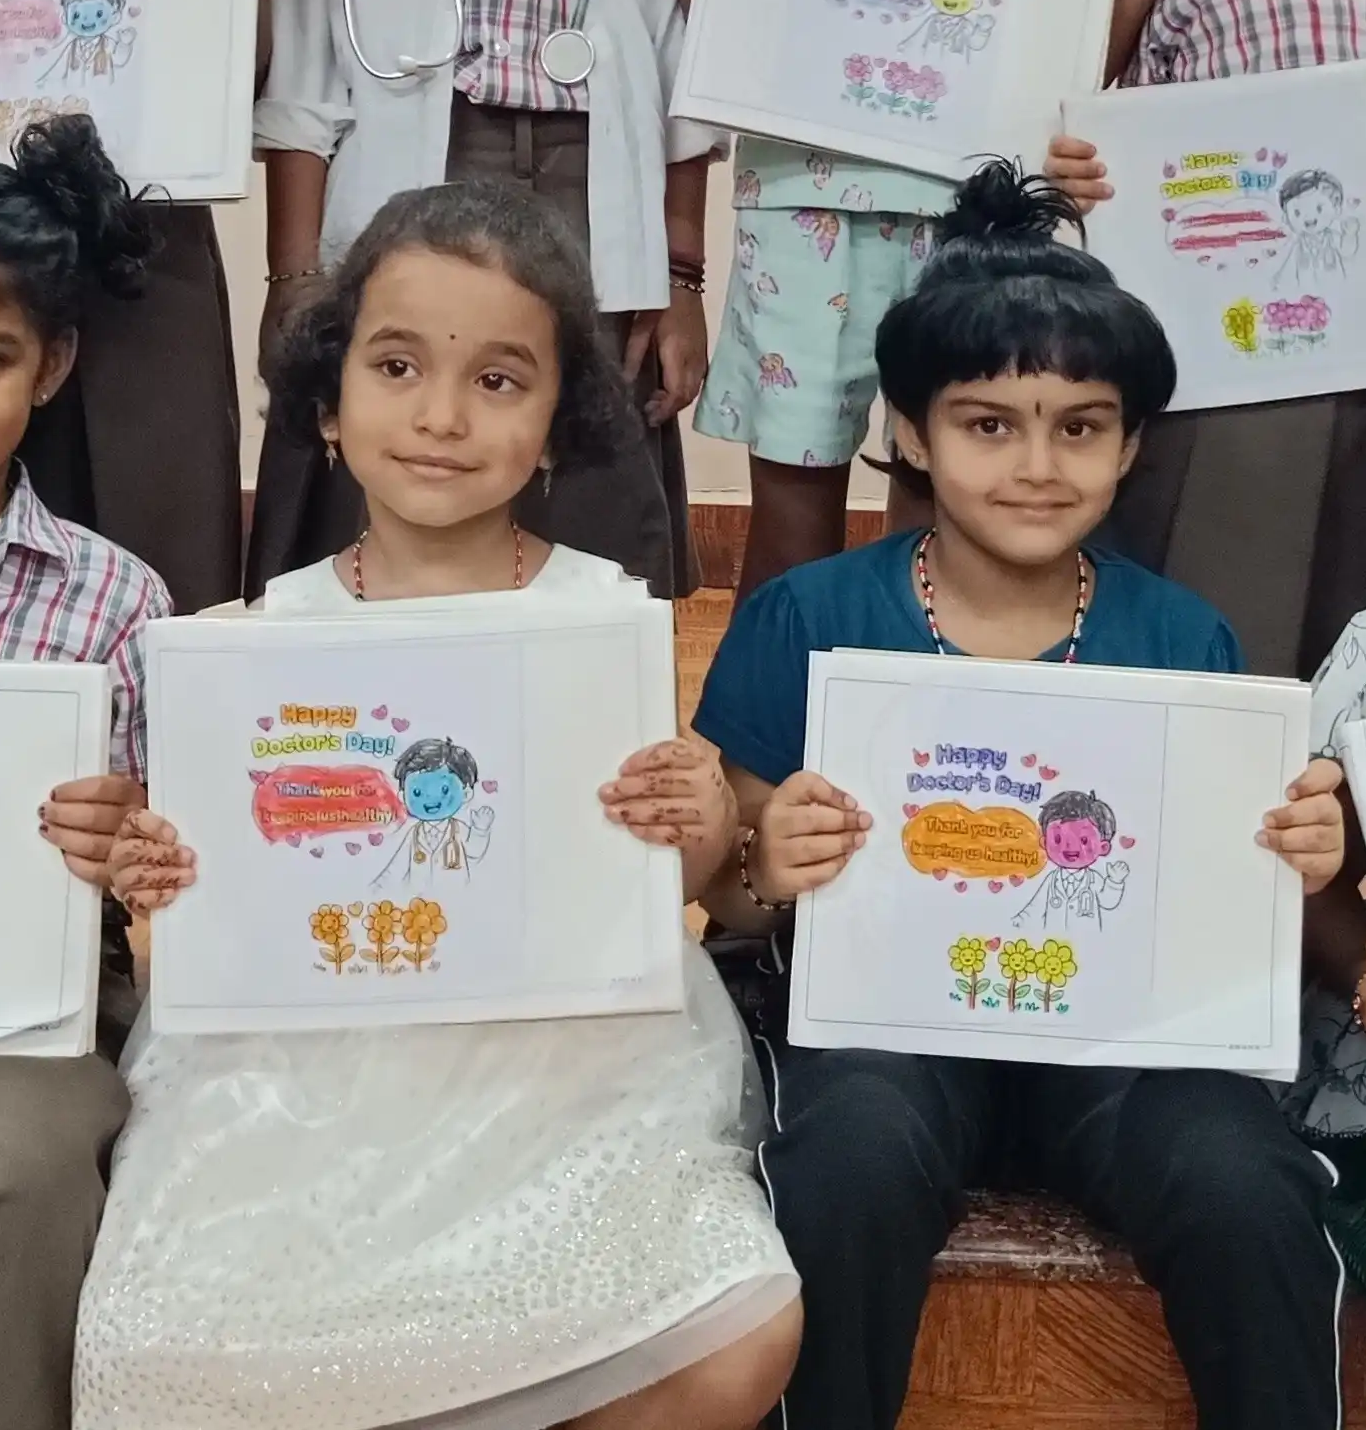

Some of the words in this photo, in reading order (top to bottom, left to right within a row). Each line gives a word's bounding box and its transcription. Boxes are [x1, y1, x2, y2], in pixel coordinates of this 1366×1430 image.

[1160, 173, 1234, 199] Doctor's
[279, 702, 357, 728] Happy
[251, 731, 342, 758] Doctor's
[345, 731, 395, 758] Day!
[935, 743, 1008, 770] Happy
[906, 771, 992, 793] Doctor's
[995, 773, 1042, 804] Day!
[924, 816, 969, 832] Thank
[971, 822, 997, 838] you
[999, 822, 1024, 839] for
[910, 841, 963, 860] keeping
[965, 848, 982, 858] us
